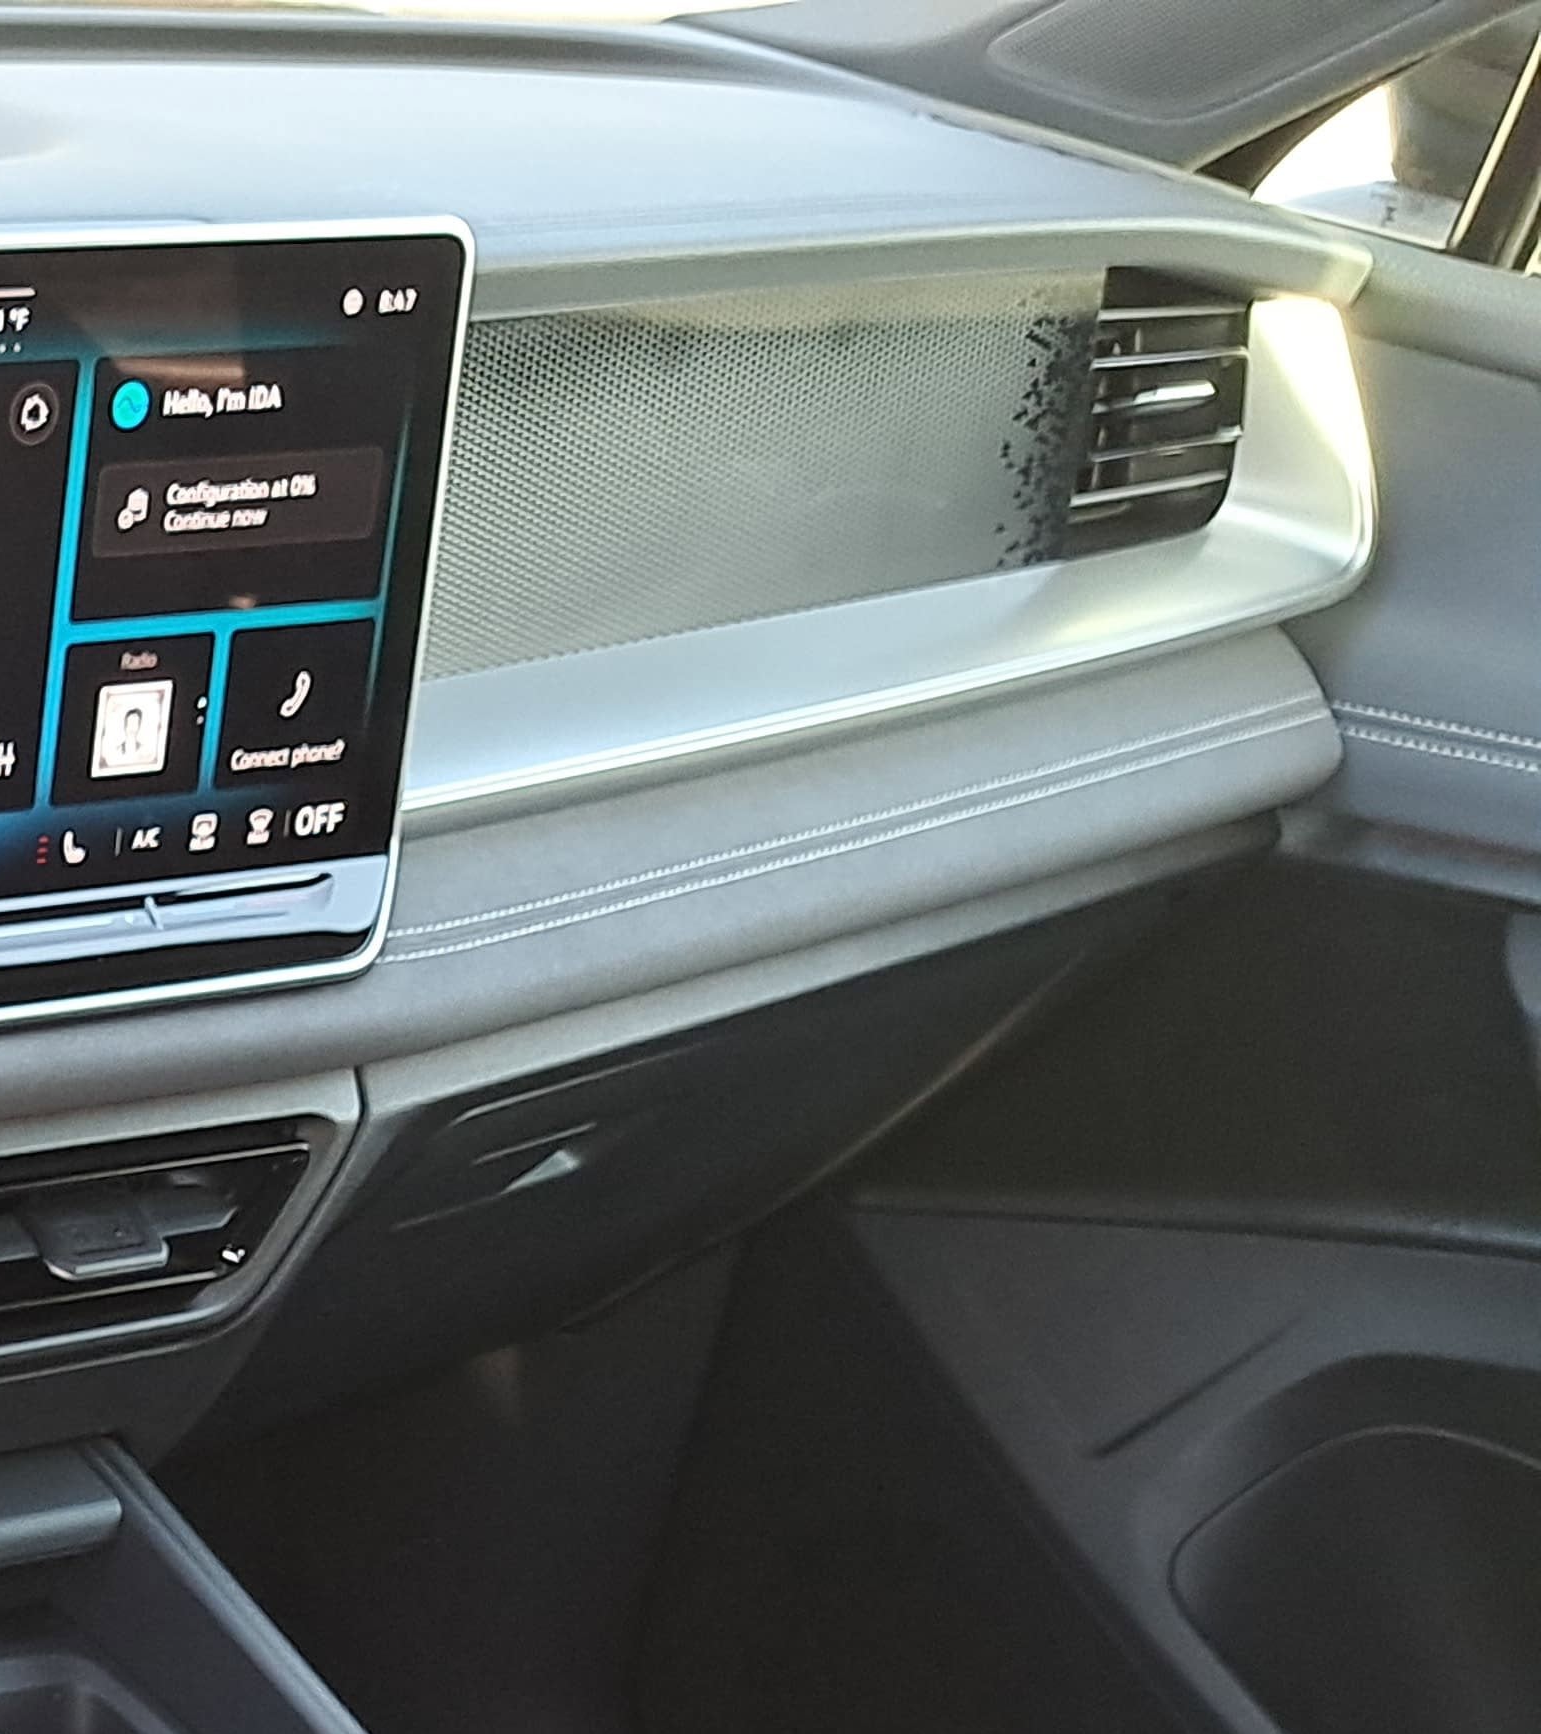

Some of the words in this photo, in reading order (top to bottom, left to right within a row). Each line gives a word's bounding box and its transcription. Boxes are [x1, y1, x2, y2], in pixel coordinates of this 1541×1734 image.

[163, 388, 213, 419] Hello,
[248, 384, 282, 410] IDA
[167, 477, 269, 508] Configuration
[164, 509, 230, 532] Continue
[231, 508, 268, 528] now
[230, 746, 290, 772] Connect
[293, 801, 346, 836] OFF
